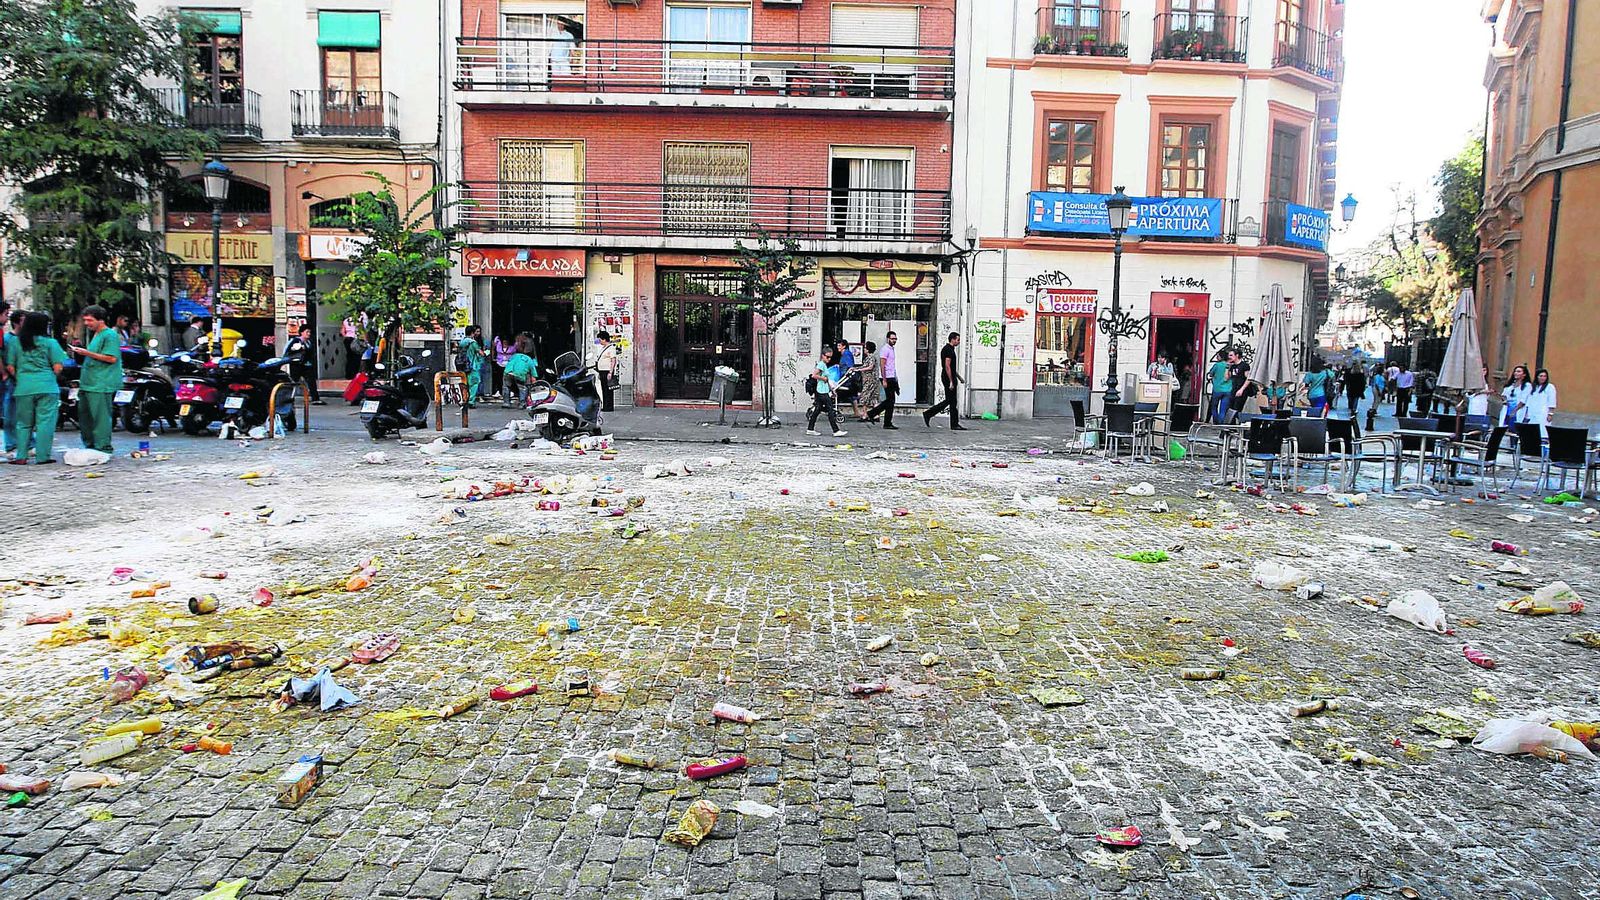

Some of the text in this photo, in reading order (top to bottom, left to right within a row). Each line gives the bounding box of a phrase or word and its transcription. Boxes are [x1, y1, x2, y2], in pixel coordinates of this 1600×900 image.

[1064, 201, 1098, 209] Consulta
[1140, 202, 1210, 217] PRÓXIMA
[1138, 217, 1211, 231] APERTURA
[183, 237, 259, 259] LA CEPERIE
[469, 256, 583, 273] SAMARCANDA
[1054, 295, 1097, 304] DUNKIN'
[1053, 303, 1094, 312] COFFEE
